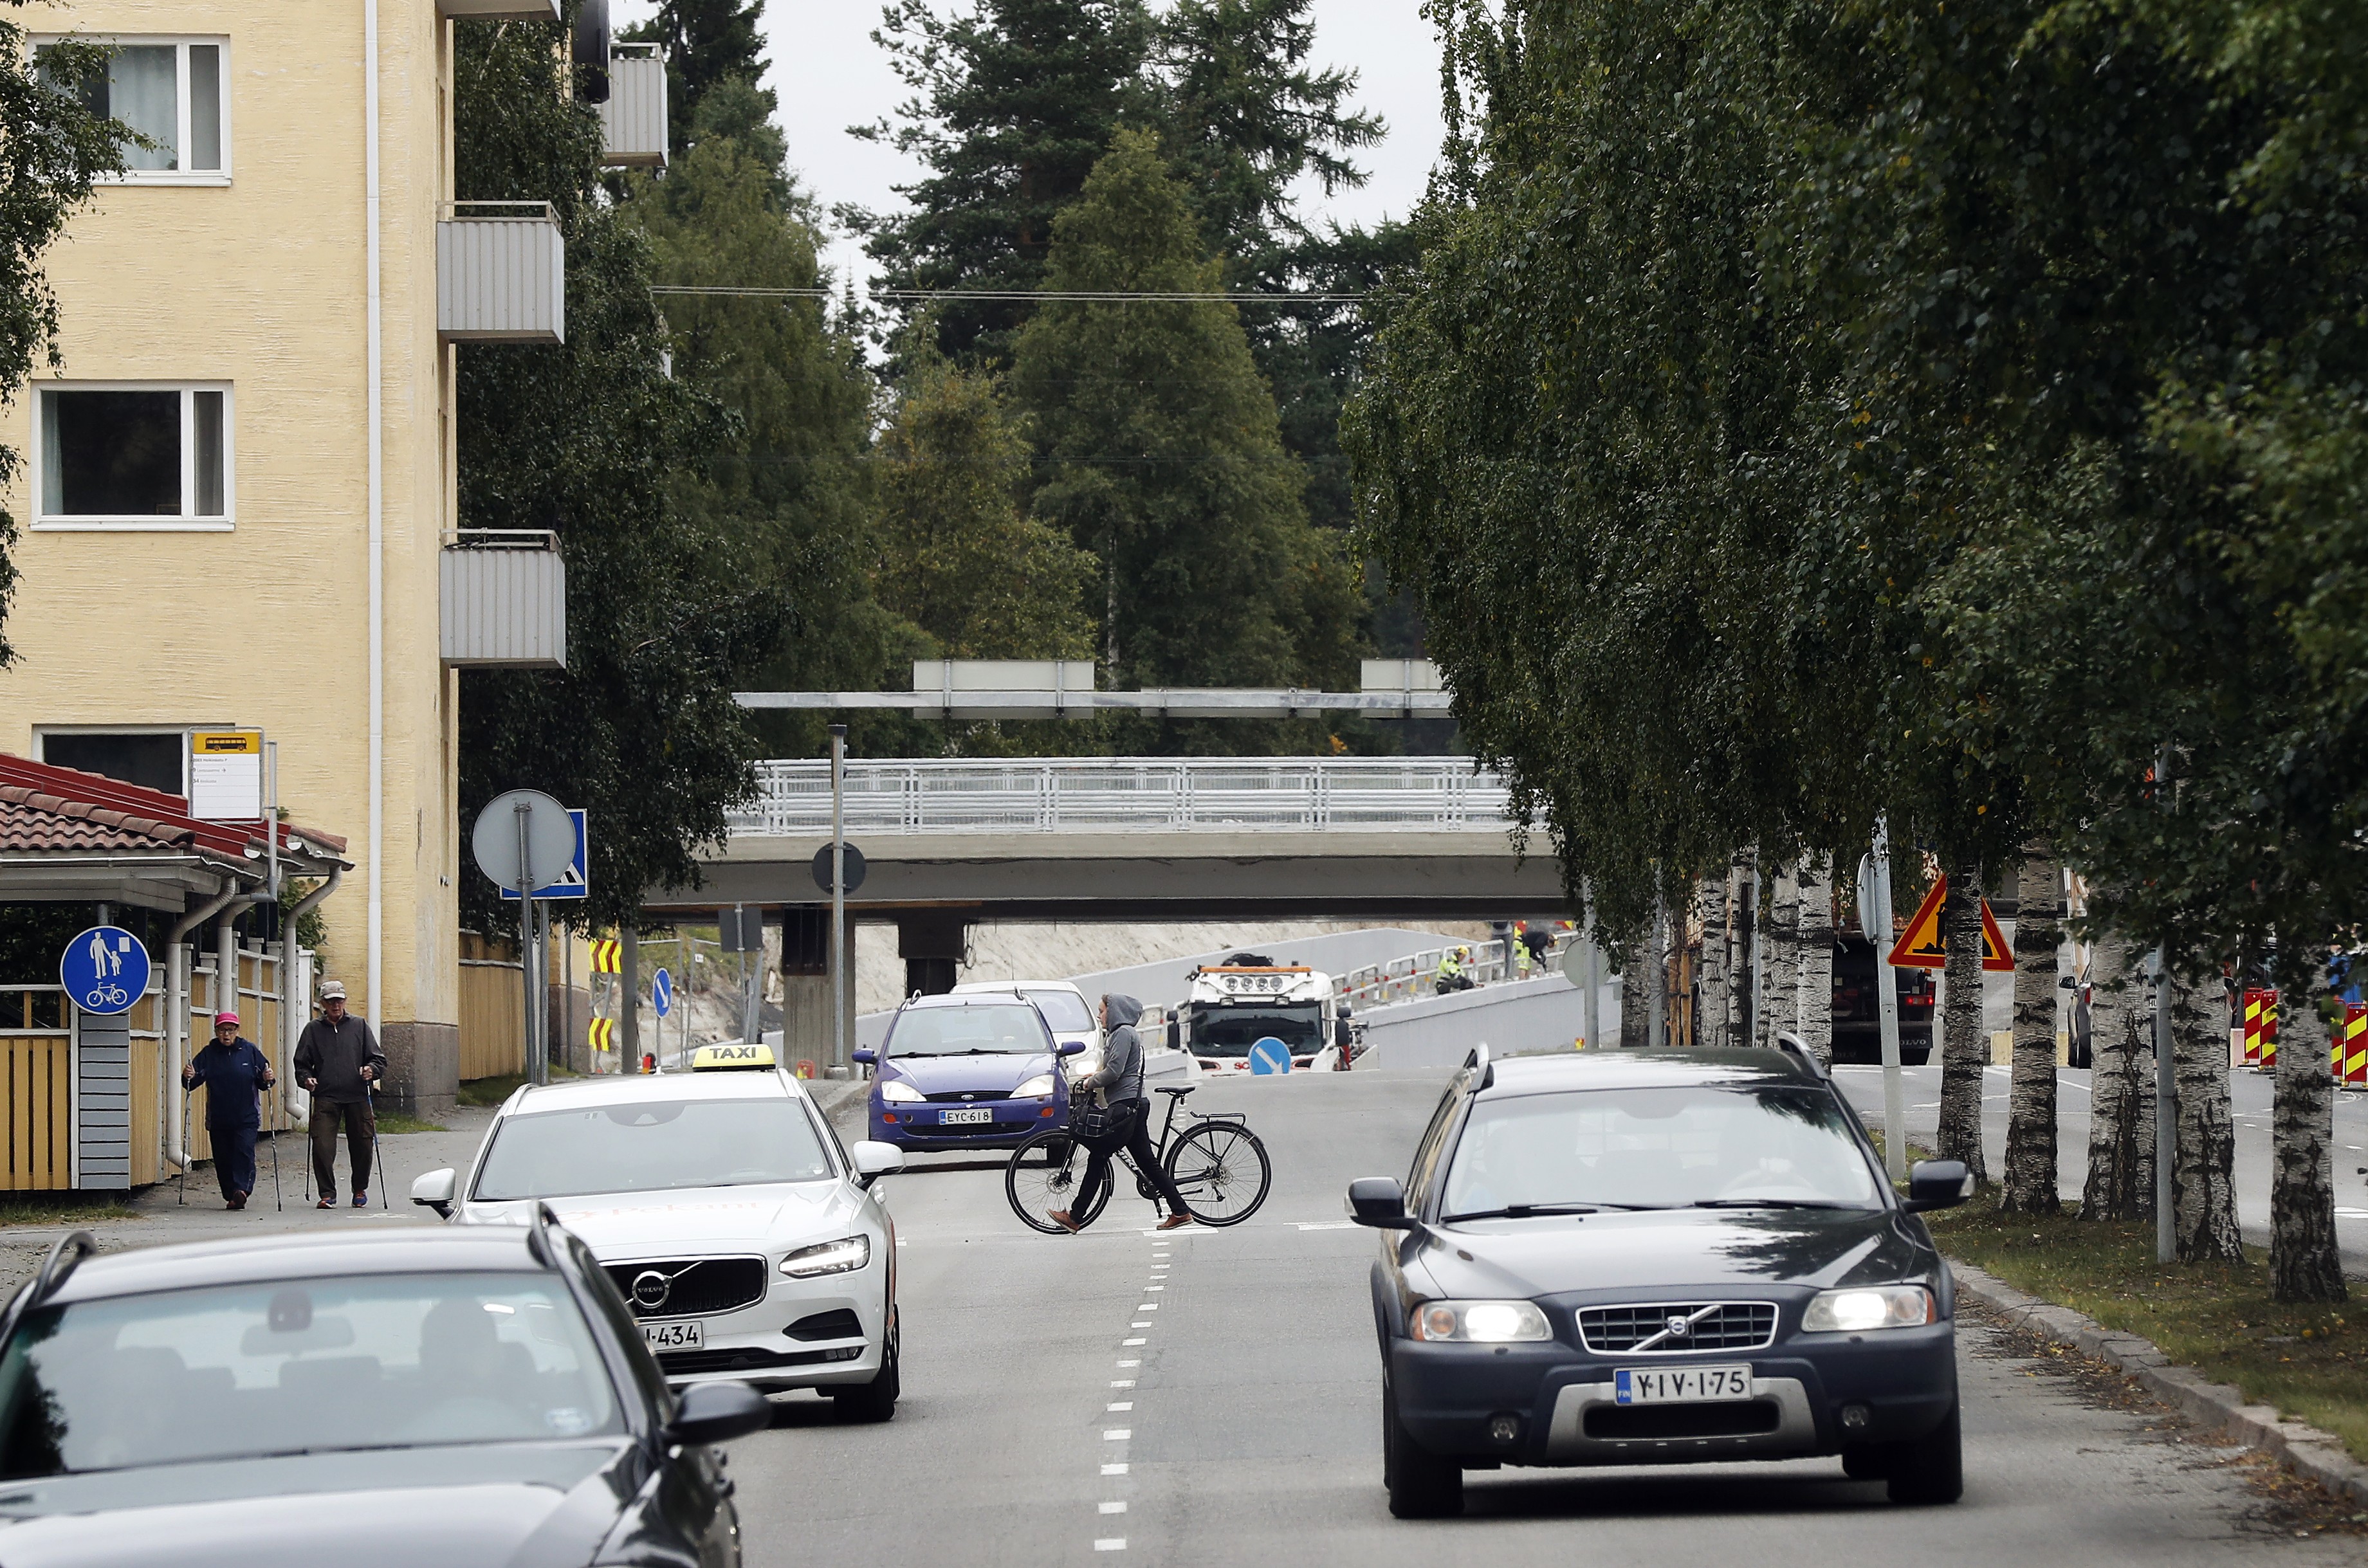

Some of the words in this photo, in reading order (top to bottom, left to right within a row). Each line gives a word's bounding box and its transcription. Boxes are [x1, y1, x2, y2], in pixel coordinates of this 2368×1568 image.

[709, 1047, 756, 1059] TAXI
[948, 1111, 989, 1122] EYC-618
[1618, 1390, 1631, 1398] FIN
[1637, 1371, 1746, 1398] YIV-175
